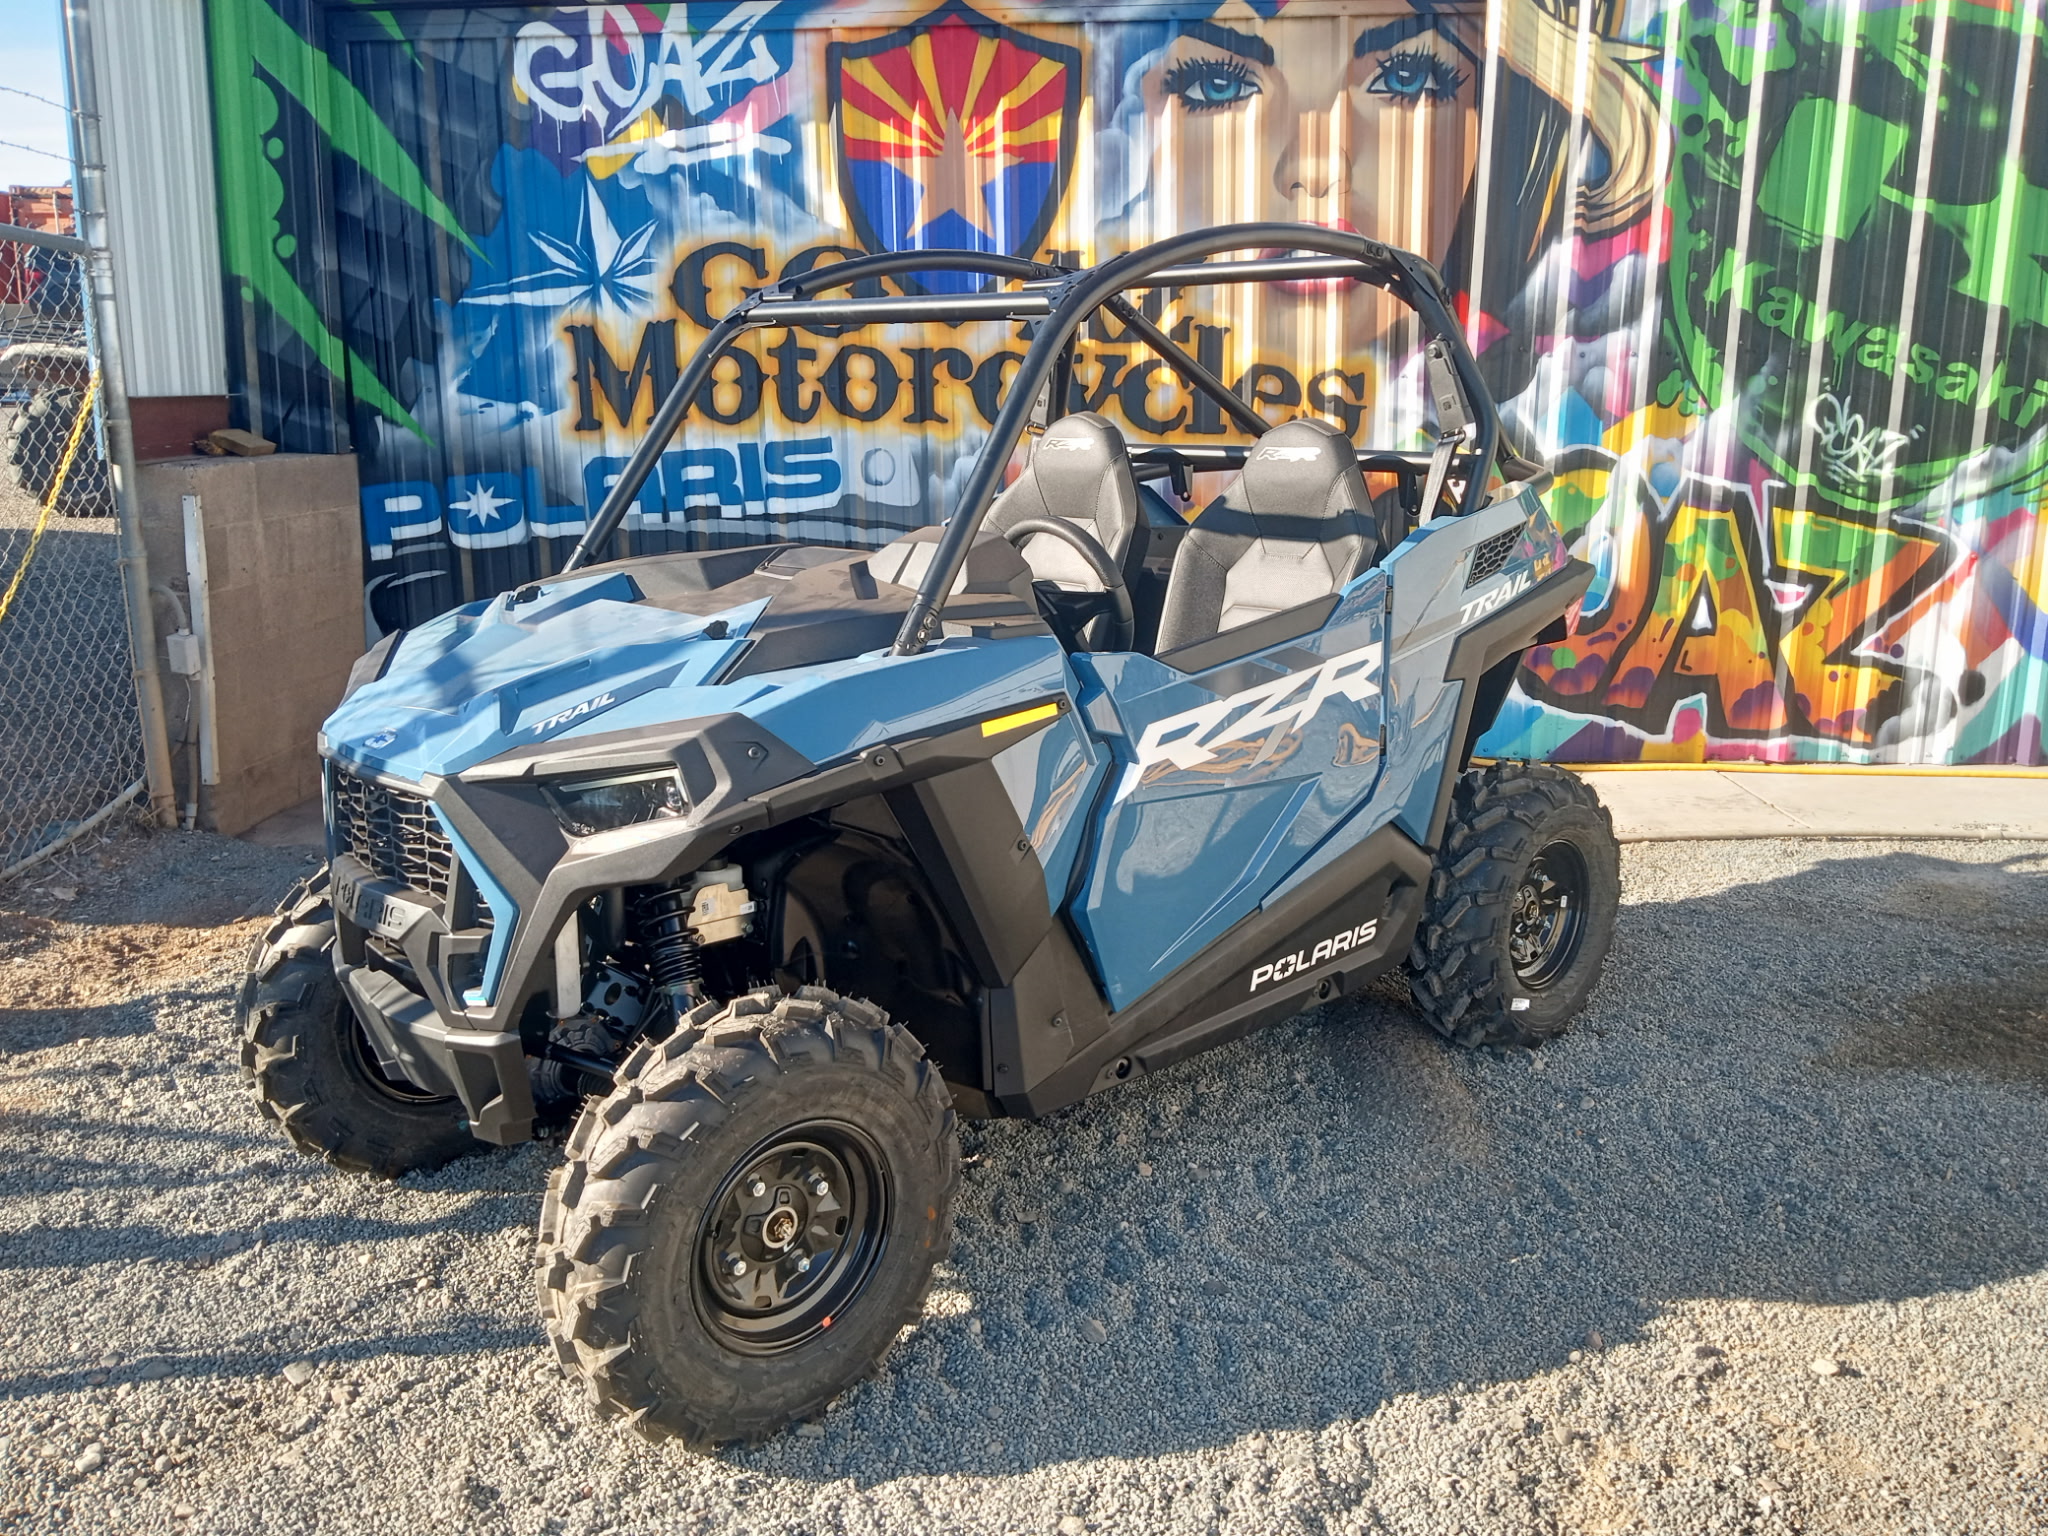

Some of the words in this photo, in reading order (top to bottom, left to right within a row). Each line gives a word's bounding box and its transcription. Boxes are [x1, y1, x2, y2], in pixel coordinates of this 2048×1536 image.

[1704, 247, 2048, 429] Kawasaki
[361, 436, 841, 560] POLARIS
[1460, 569, 1531, 624] TRAIL
[531, 693, 616, 736] TRAIL
[1114, 641, 1383, 806] RZR
[1250, 918, 1378, 992] POLARIS
